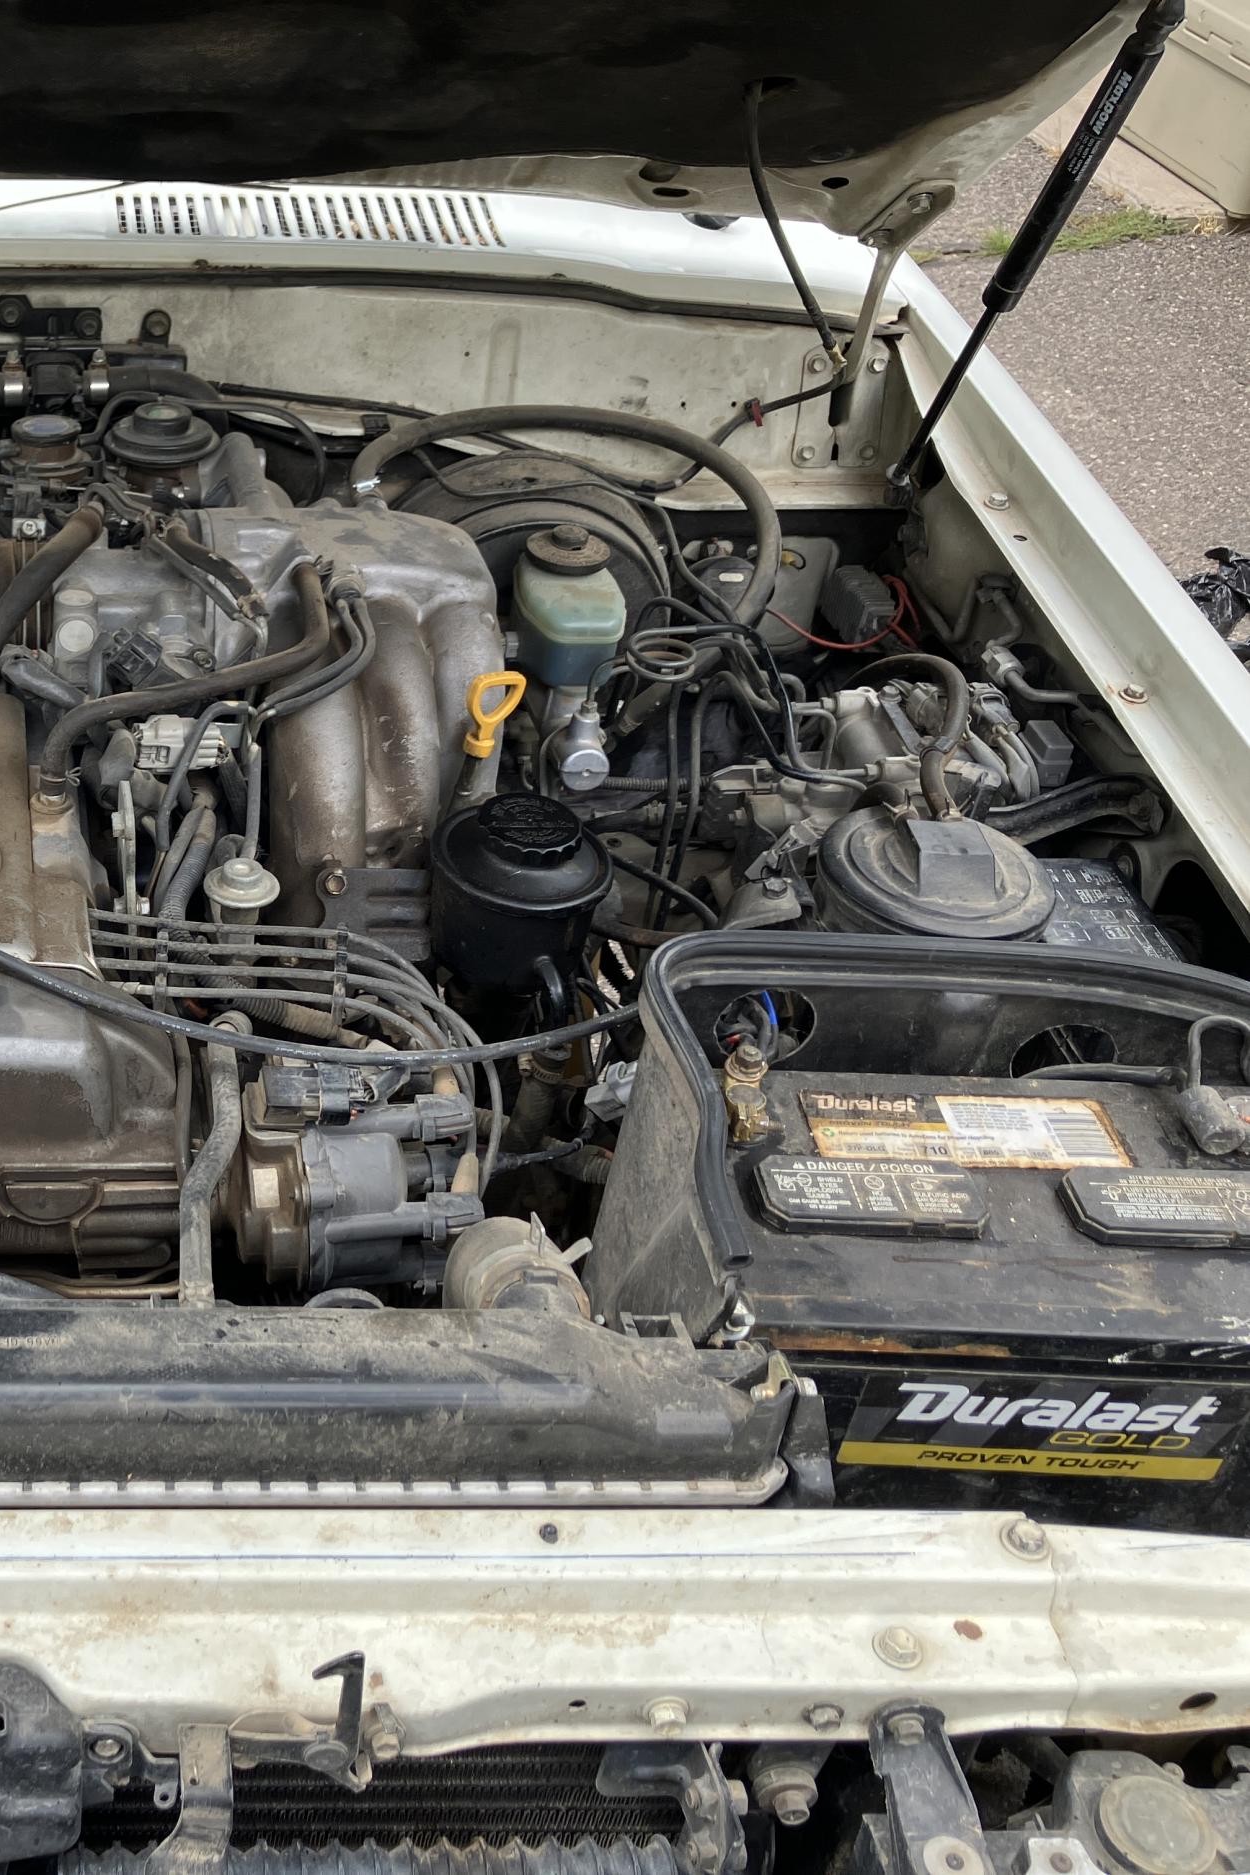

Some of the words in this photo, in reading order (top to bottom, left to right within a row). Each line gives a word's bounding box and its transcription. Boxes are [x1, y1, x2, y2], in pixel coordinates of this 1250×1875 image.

[1092, 71, 1132, 135] Maxpow
[811, 1094, 916, 1113] Duralast
[922, 1144, 948, 1155] 710
[806, 1161, 865, 1171] DANGER
[880, 1163, 934, 1173] POISON
[896, 1382, 1219, 1434] Duralast
[1049, 1431, 1191, 1450] GOLD
[918, 1450, 1036, 1466] PROVEN
[1045, 1456, 1140, 1470] TOUGH
